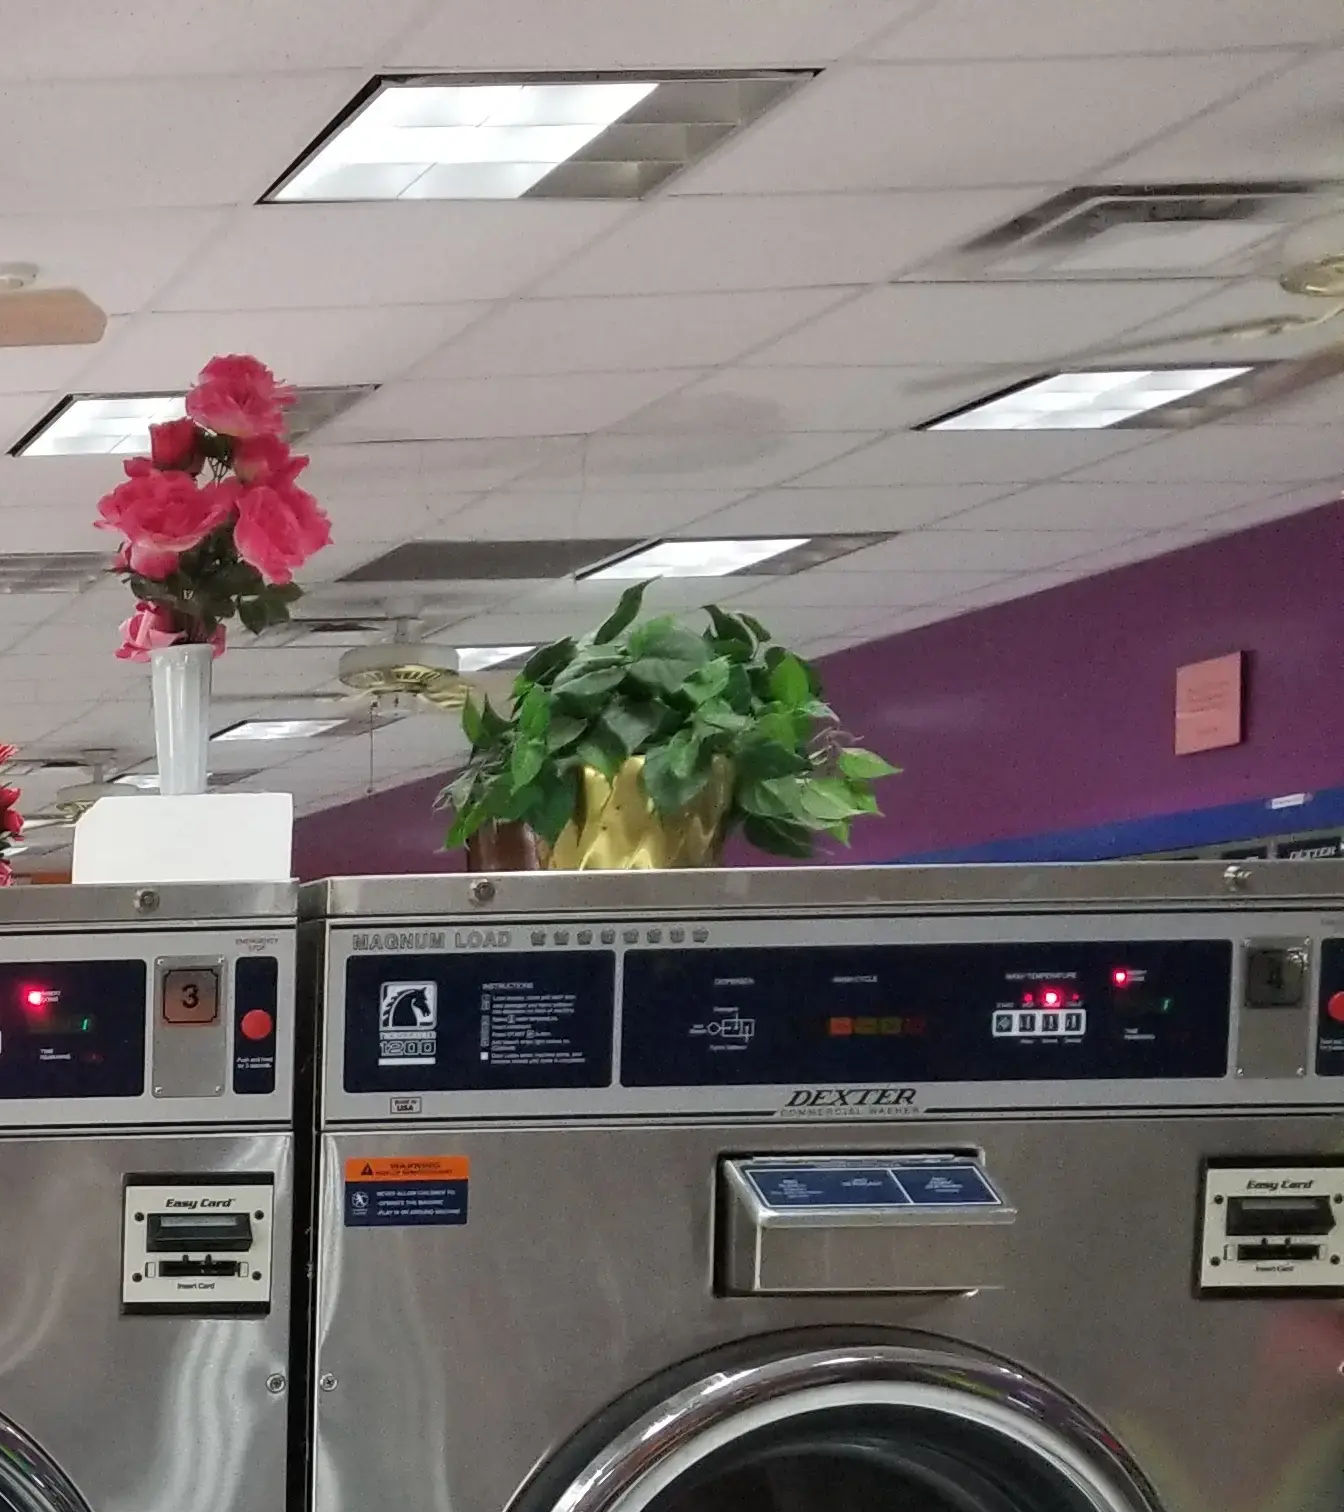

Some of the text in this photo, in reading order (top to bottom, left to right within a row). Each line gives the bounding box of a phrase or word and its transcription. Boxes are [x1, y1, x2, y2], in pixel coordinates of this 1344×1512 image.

[353, 931, 512, 950] MAGNUM LOAD
[182, 984, 199, 1009] 3
[381, 1040, 436, 1056] 1200
[786, 1089, 916, 1107] DEXTER
[1247, 1179, 1314, 1191] Easy Card
[166, 1199, 232, 1209] Easy Card
